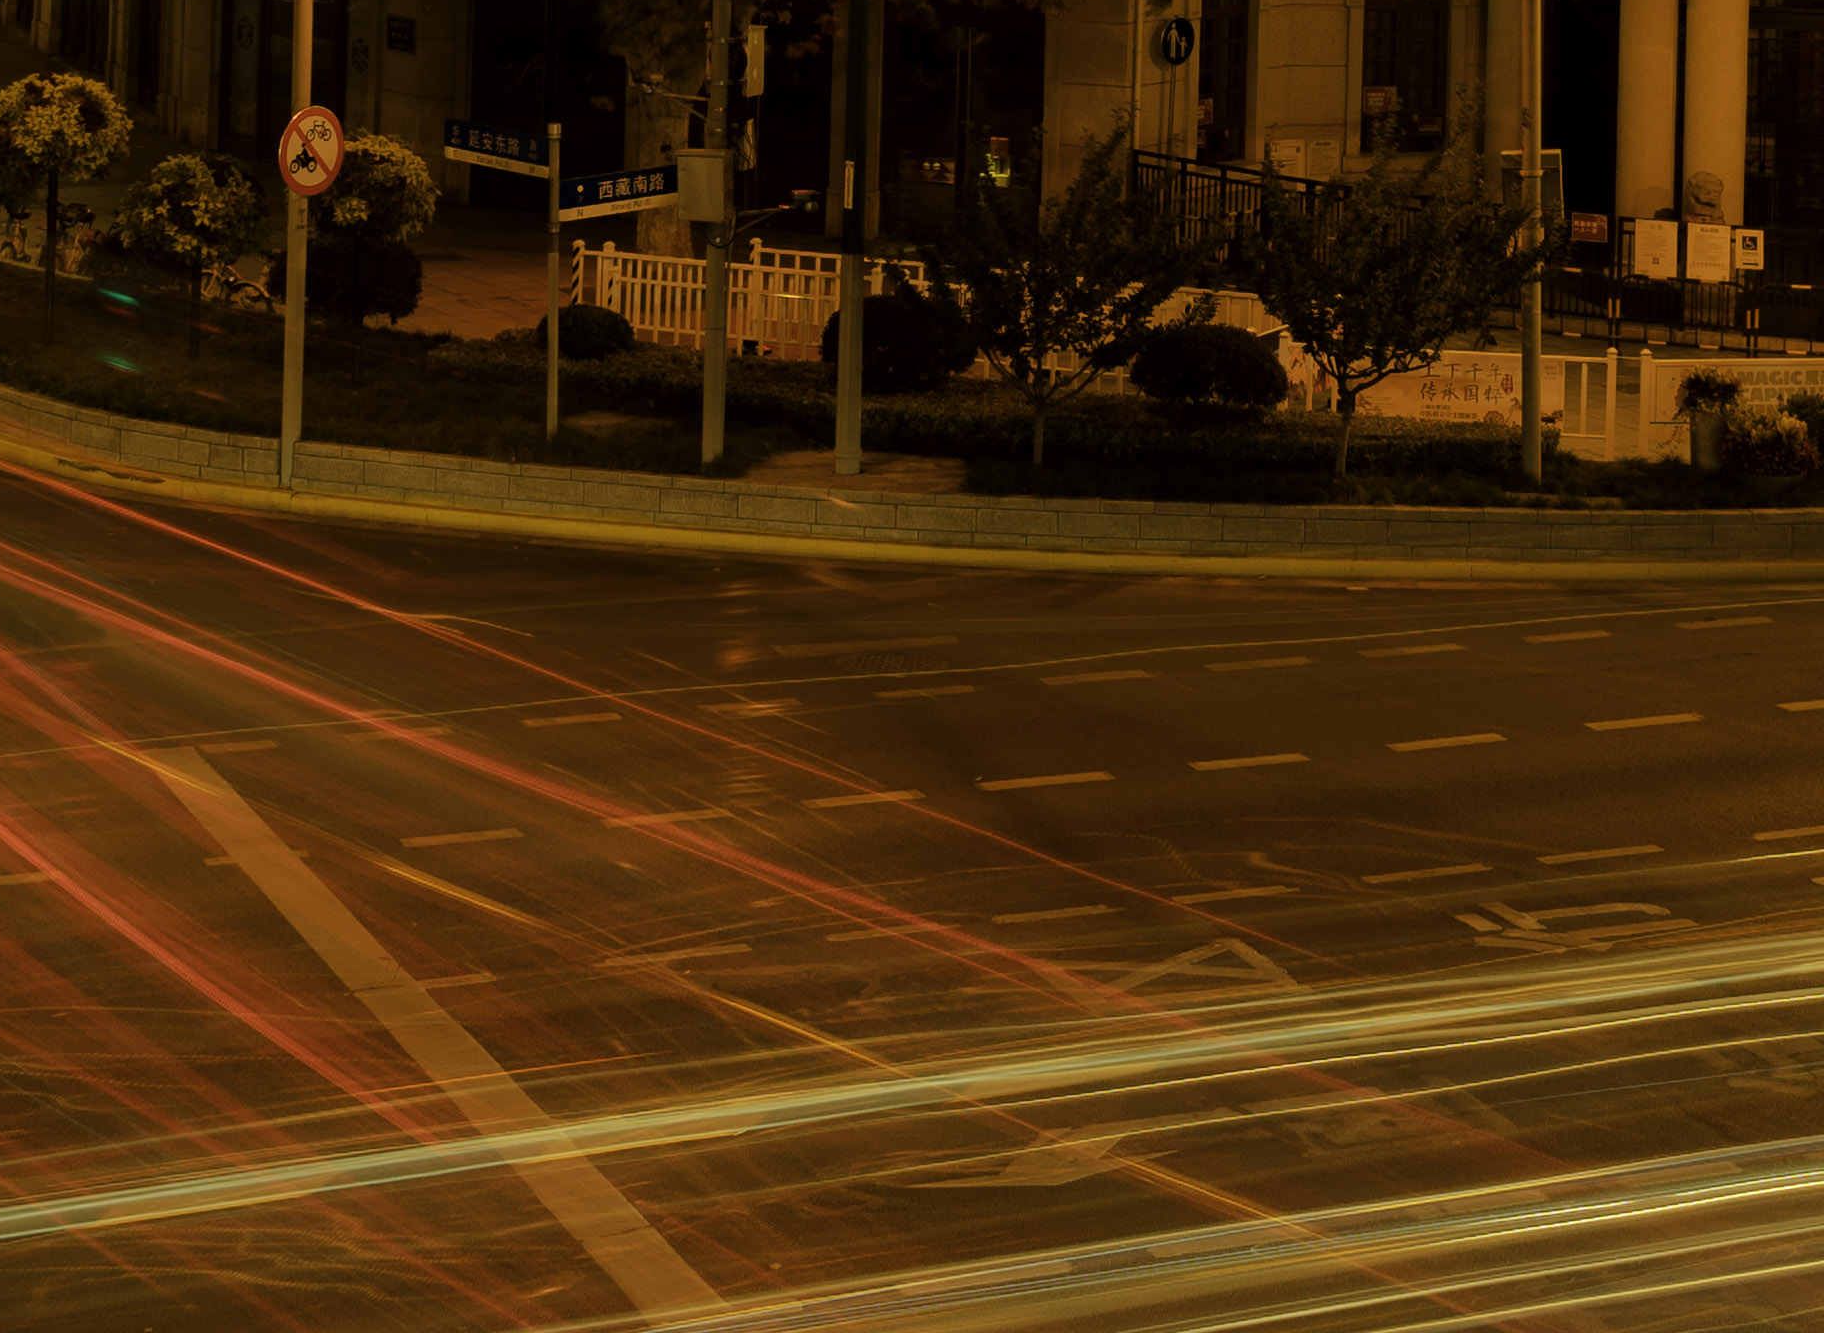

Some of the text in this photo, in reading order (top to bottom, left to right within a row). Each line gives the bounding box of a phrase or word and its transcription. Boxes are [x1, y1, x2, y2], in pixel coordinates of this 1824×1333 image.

[468, 129, 520, 157] 延安东路
[597, 172, 665, 200] 西藏南路
[576, 208, 584, 217] N
[1735, 370, 1803, 384] MAGIC
[1419, 382, 1505, 405] 传承国粹
